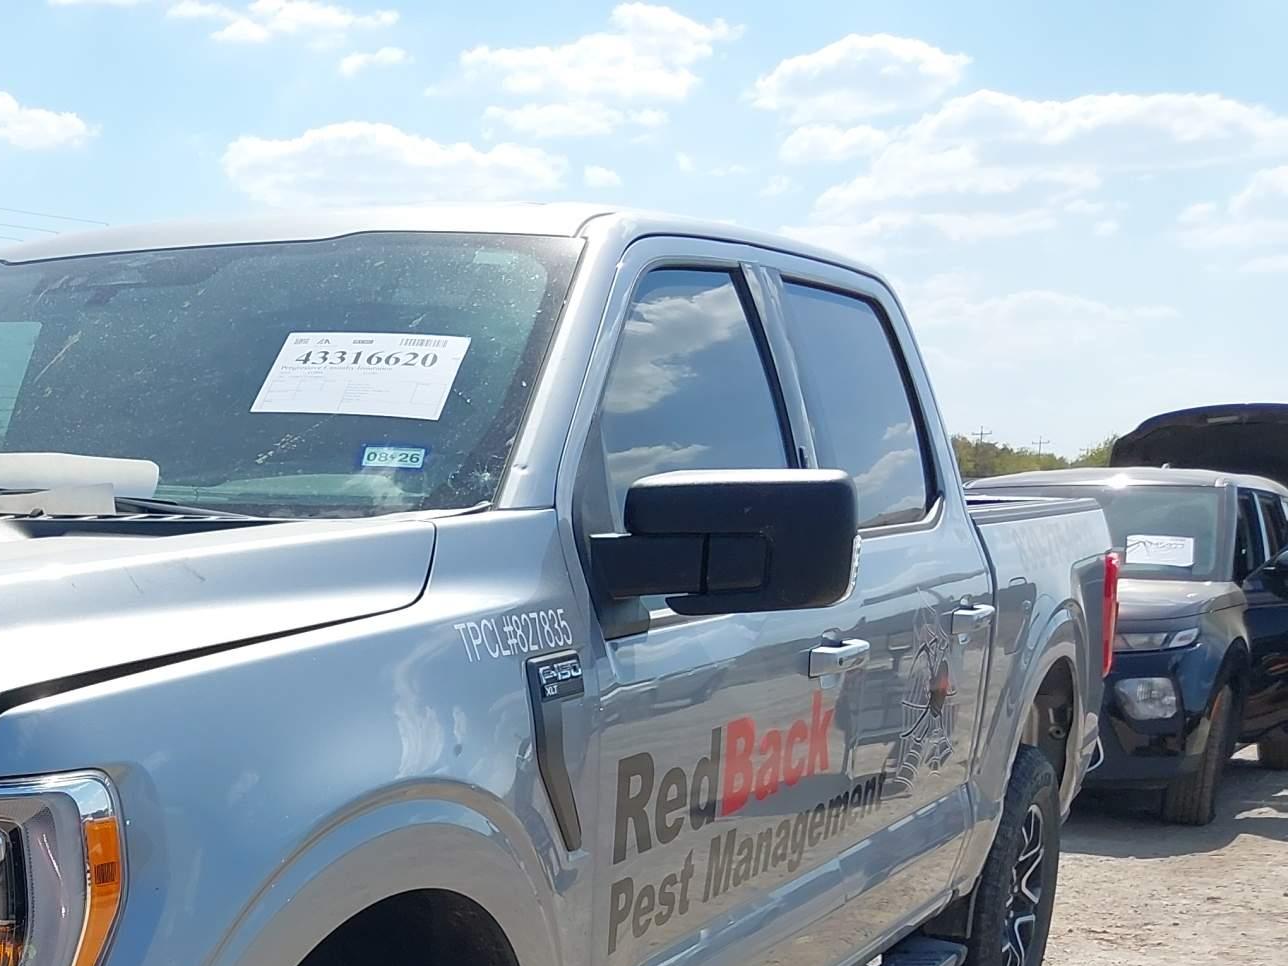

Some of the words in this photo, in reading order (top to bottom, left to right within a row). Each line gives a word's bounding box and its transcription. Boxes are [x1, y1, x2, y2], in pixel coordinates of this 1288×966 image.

[295, 350, 438, 368] 43316620
[398, 453, 420, 464] 26
[454, 608, 573, 662] TPCL#827835
[539, 659, 582, 685] F-150
[545, 683, 559, 697] XLT
[607, 848, 696, 957] Pest
[701, 771, 887, 904] Management
